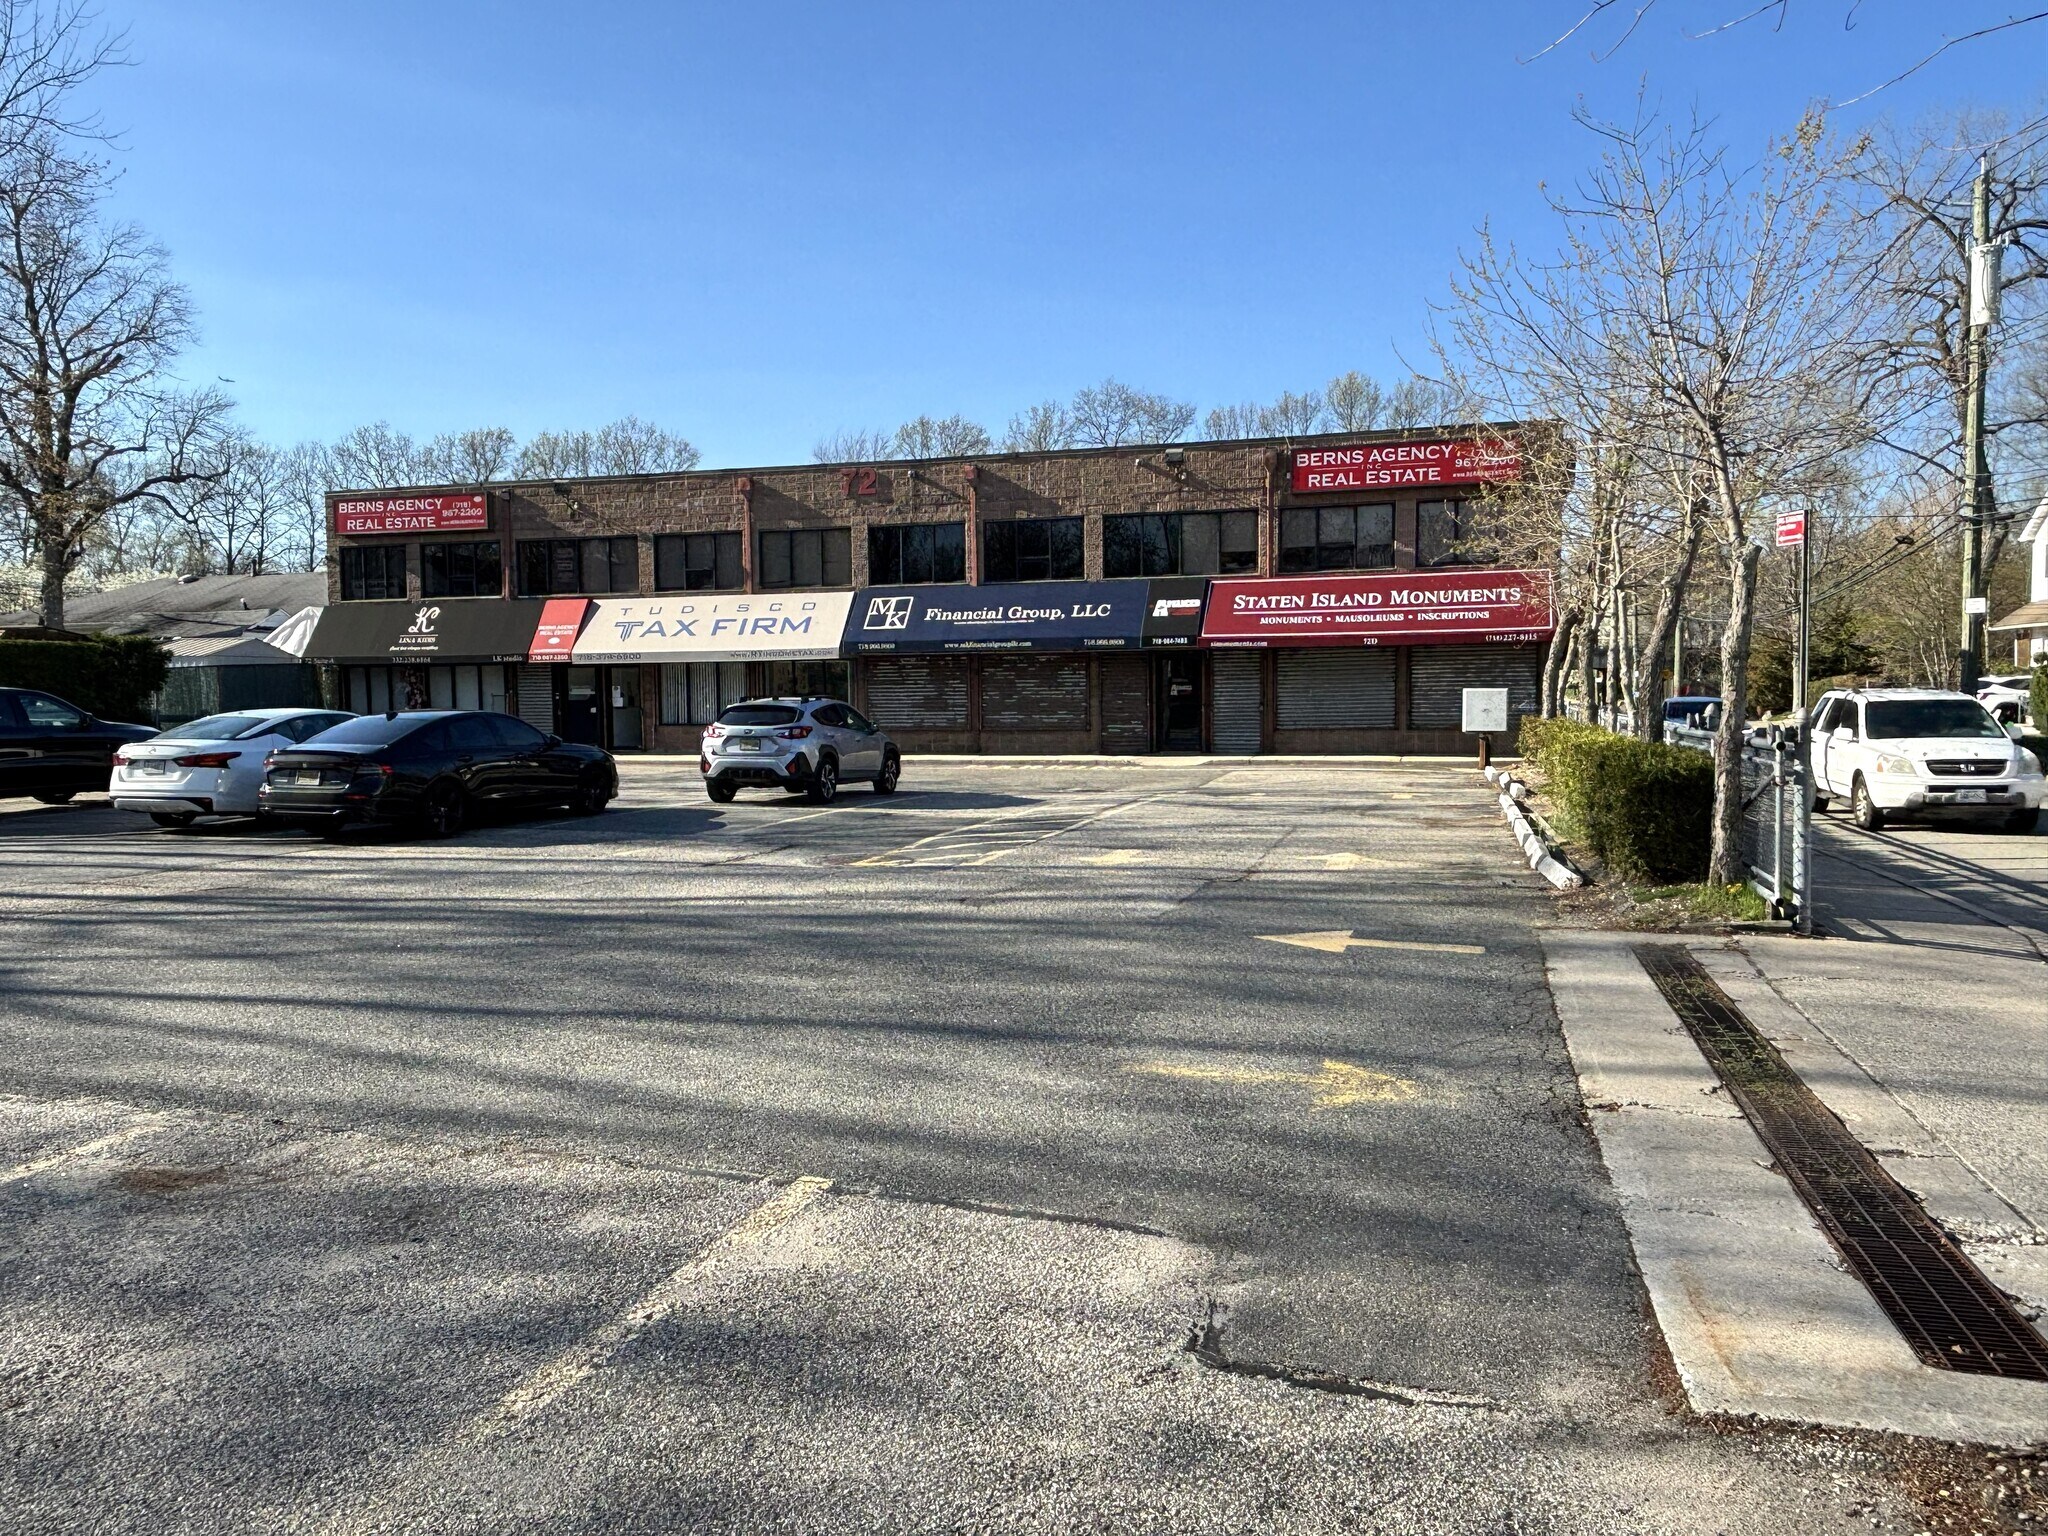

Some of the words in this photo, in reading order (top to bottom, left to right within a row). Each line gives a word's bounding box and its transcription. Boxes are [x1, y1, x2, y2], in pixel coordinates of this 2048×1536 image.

[1296, 450, 1364, 467] BERNS
[1368, 445, 1453, 462] AGENCY
[840, 467, 878, 499] 72
[1308, 471, 1361, 488] REAL
[1366, 468, 1442, 484] ESTATE
[338, 501, 384, 514] BERNS
[387, 498, 443, 511] AGENCY
[347, 519, 382, 530] REAL
[386, 517, 436, 529] ESTATE
[1233, 594, 1305, 610] STATEN
[1310, 592, 1382, 608] ISLAND
[1389, 588, 1521, 606] MONUMENTS
[620, 602, 817, 616] TUDISCO
[924, 606, 1003, 621] Financial
[1007, 606, 1066, 620] Group,
[1071, 604, 1111, 618] LLC
[1259, 615, 1323, 625] MONUMENTS
[1335, 612, 1405, 624] MAUSOLEUMS
[1417, 611, 1490, 621] INSCRIPTIONS
[614, 619, 700, 642] TAX
[711, 616, 812, 637] FIRM
